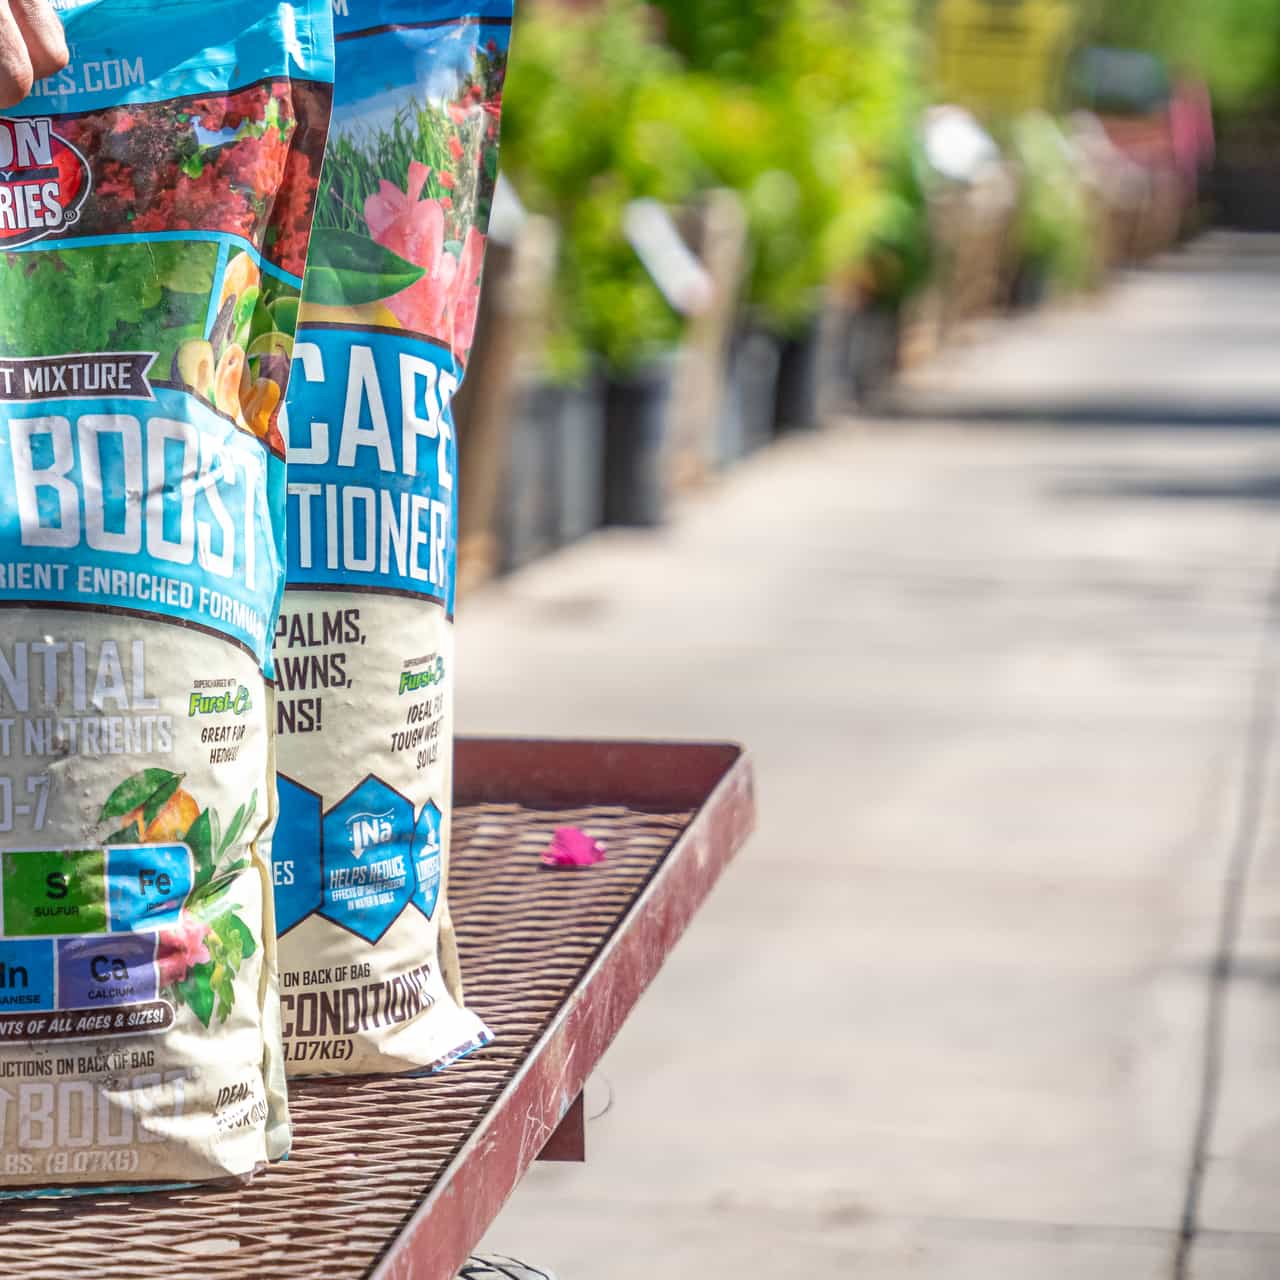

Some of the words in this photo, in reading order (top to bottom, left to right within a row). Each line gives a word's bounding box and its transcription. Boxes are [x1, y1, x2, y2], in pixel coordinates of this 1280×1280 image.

[23, 361, 134, 394] MIXTURE
[8, 414, 264, 591] BOOST
[76, 565, 193, 609] ENRICHED
[406, 700, 432, 725] IDEAL
[24, 715, 173, 757] NUTRIENTS
[201, 725, 231, 743] GREAT
[390, 726, 425, 753] TOUGH
[46, 871, 69, 900] S
[139, 868, 172, 897] Fe
[330, 866, 368, 890] HELPS
[369, 855, 406, 883] REDUCE
[34, 905, 80, 918] SULFUR
[91, 956, 130, 983] Ca
[283, 971, 300, 988] ON
[302, 967, 333, 986] BACK
[334, 965, 348, 983] OF
[350, 963, 371, 981] BAG
[88, 987, 135, 1000] CALCIUM
[26, 1019, 45, 1035] OF
[47, 1017, 72, 1033] ALL
[75, 1015, 112, 1031] AGES
[113, 1013, 125, 1028] &
[127, 1008, 165, 1026] SIZES!
[56, 1057, 75, 1076] ON
[78, 1053, 111, 1074] BACK
[131, 1050, 155, 1068] BAG
